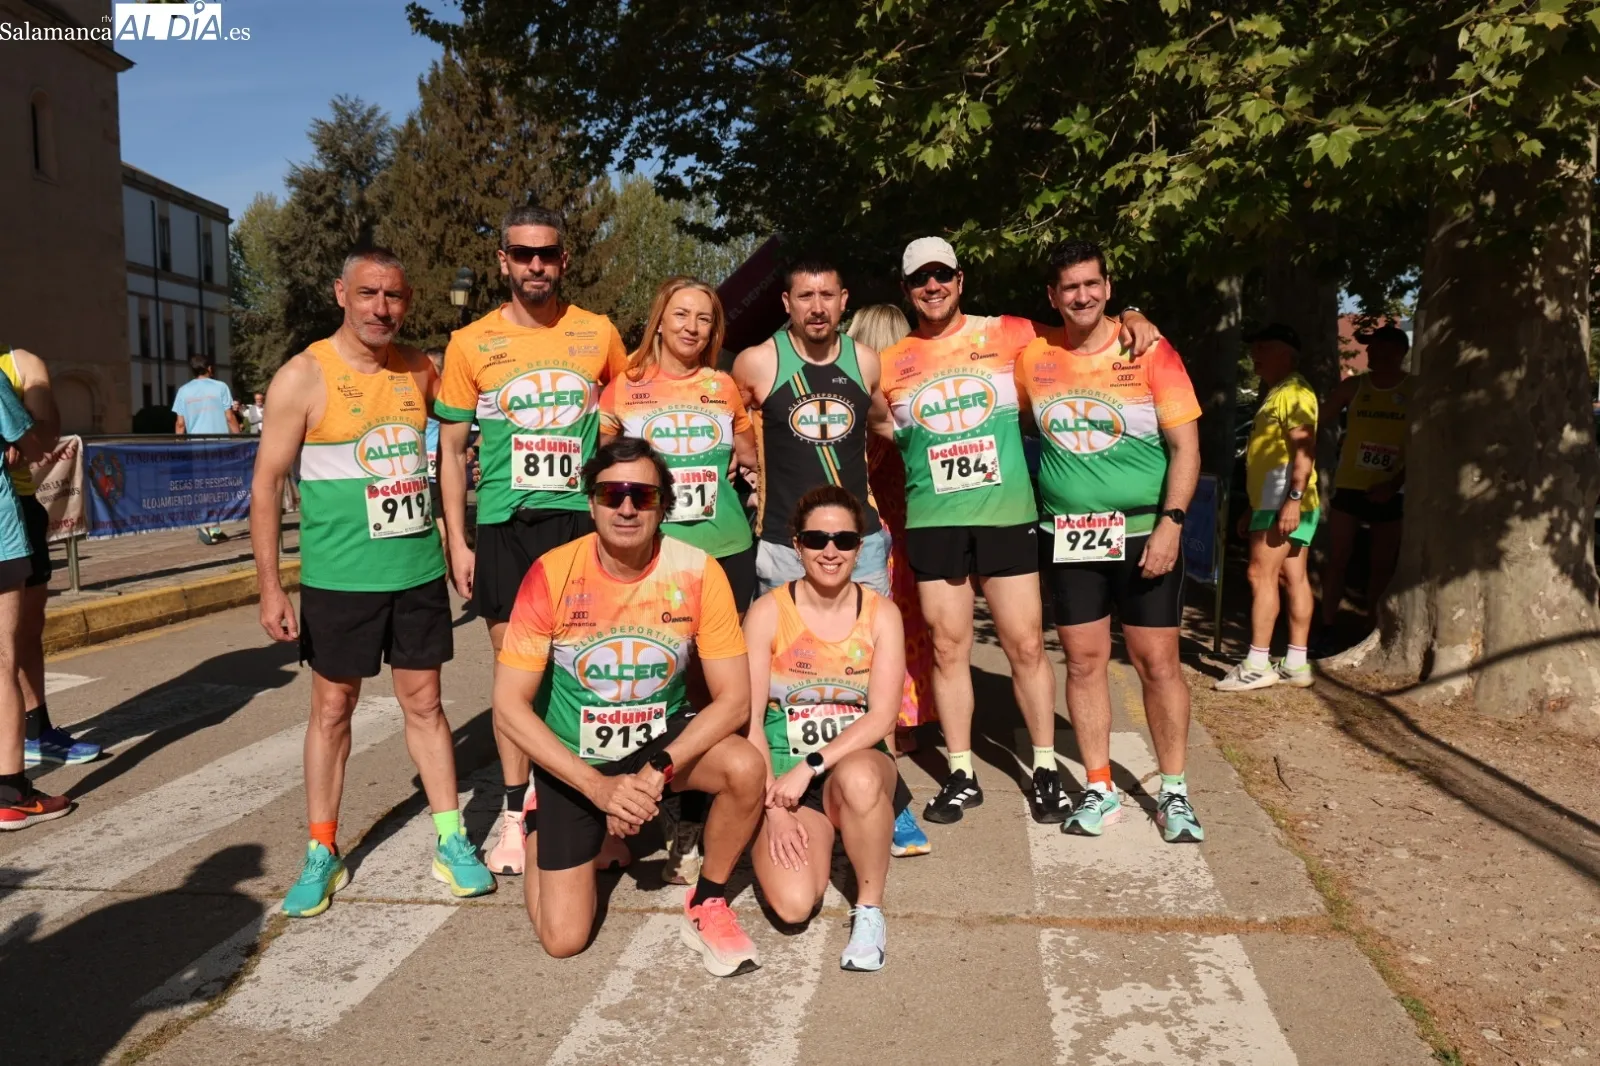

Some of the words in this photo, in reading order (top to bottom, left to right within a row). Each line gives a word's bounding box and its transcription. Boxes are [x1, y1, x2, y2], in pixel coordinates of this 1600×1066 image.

[526, 359, 593, 380] DEPORTIVO
[908, 377, 929, 398] CLUB
[932, 366, 993, 381] DEPORTIVO
[507, 389, 585, 411] ALCER
[787, 396, 807, 412] CLUB
[810, 392, 855, 409] DEPORTIVO
[919, 390, 990, 419] ALCER
[1039, 391, 1062, 410] CLUB
[1067, 388, 1124, 411] DEPORTIVO
[642, 406, 664, 421] CLUB
[668, 403, 719, 419] DEPORTIVO
[797, 413, 849, 426] ALCER
[651, 424, 716, 440] ALCER
[1047, 417, 1115, 434] ALCER
[365, 440, 420, 461] ALCER
[514, 437, 581, 454] bedunia
[929, 440, 995, 461] bedunia
[524, 453, 573, 478] 810
[940, 456, 988, 481] 784
[1362, 451, 1391, 467] 868
[169, 479, 193, 491] BECAS
[194, 478, 204, 489] DE
[205, 476, 244, 488] RESIDENCIA
[675, 468, 717, 484] unia
[368, 476, 429, 499] bedunia
[677, 483, 706, 508] 51
[142, 494, 192, 509] ALOJAMIENTO
[194, 491, 229, 505] COMPLETO
[230, 491, 236, 501] Y
[382, 493, 426, 523] 919
[1066, 528, 1114, 552] 924
[574, 632, 604, 651] CLUB
[610, 625, 680, 650] DEPORTIVO
[583, 662, 670, 681] ALCER
[787, 679, 812, 691] CLUB
[583, 707, 665, 724] bedunia
[595, 723, 653, 749] 913
